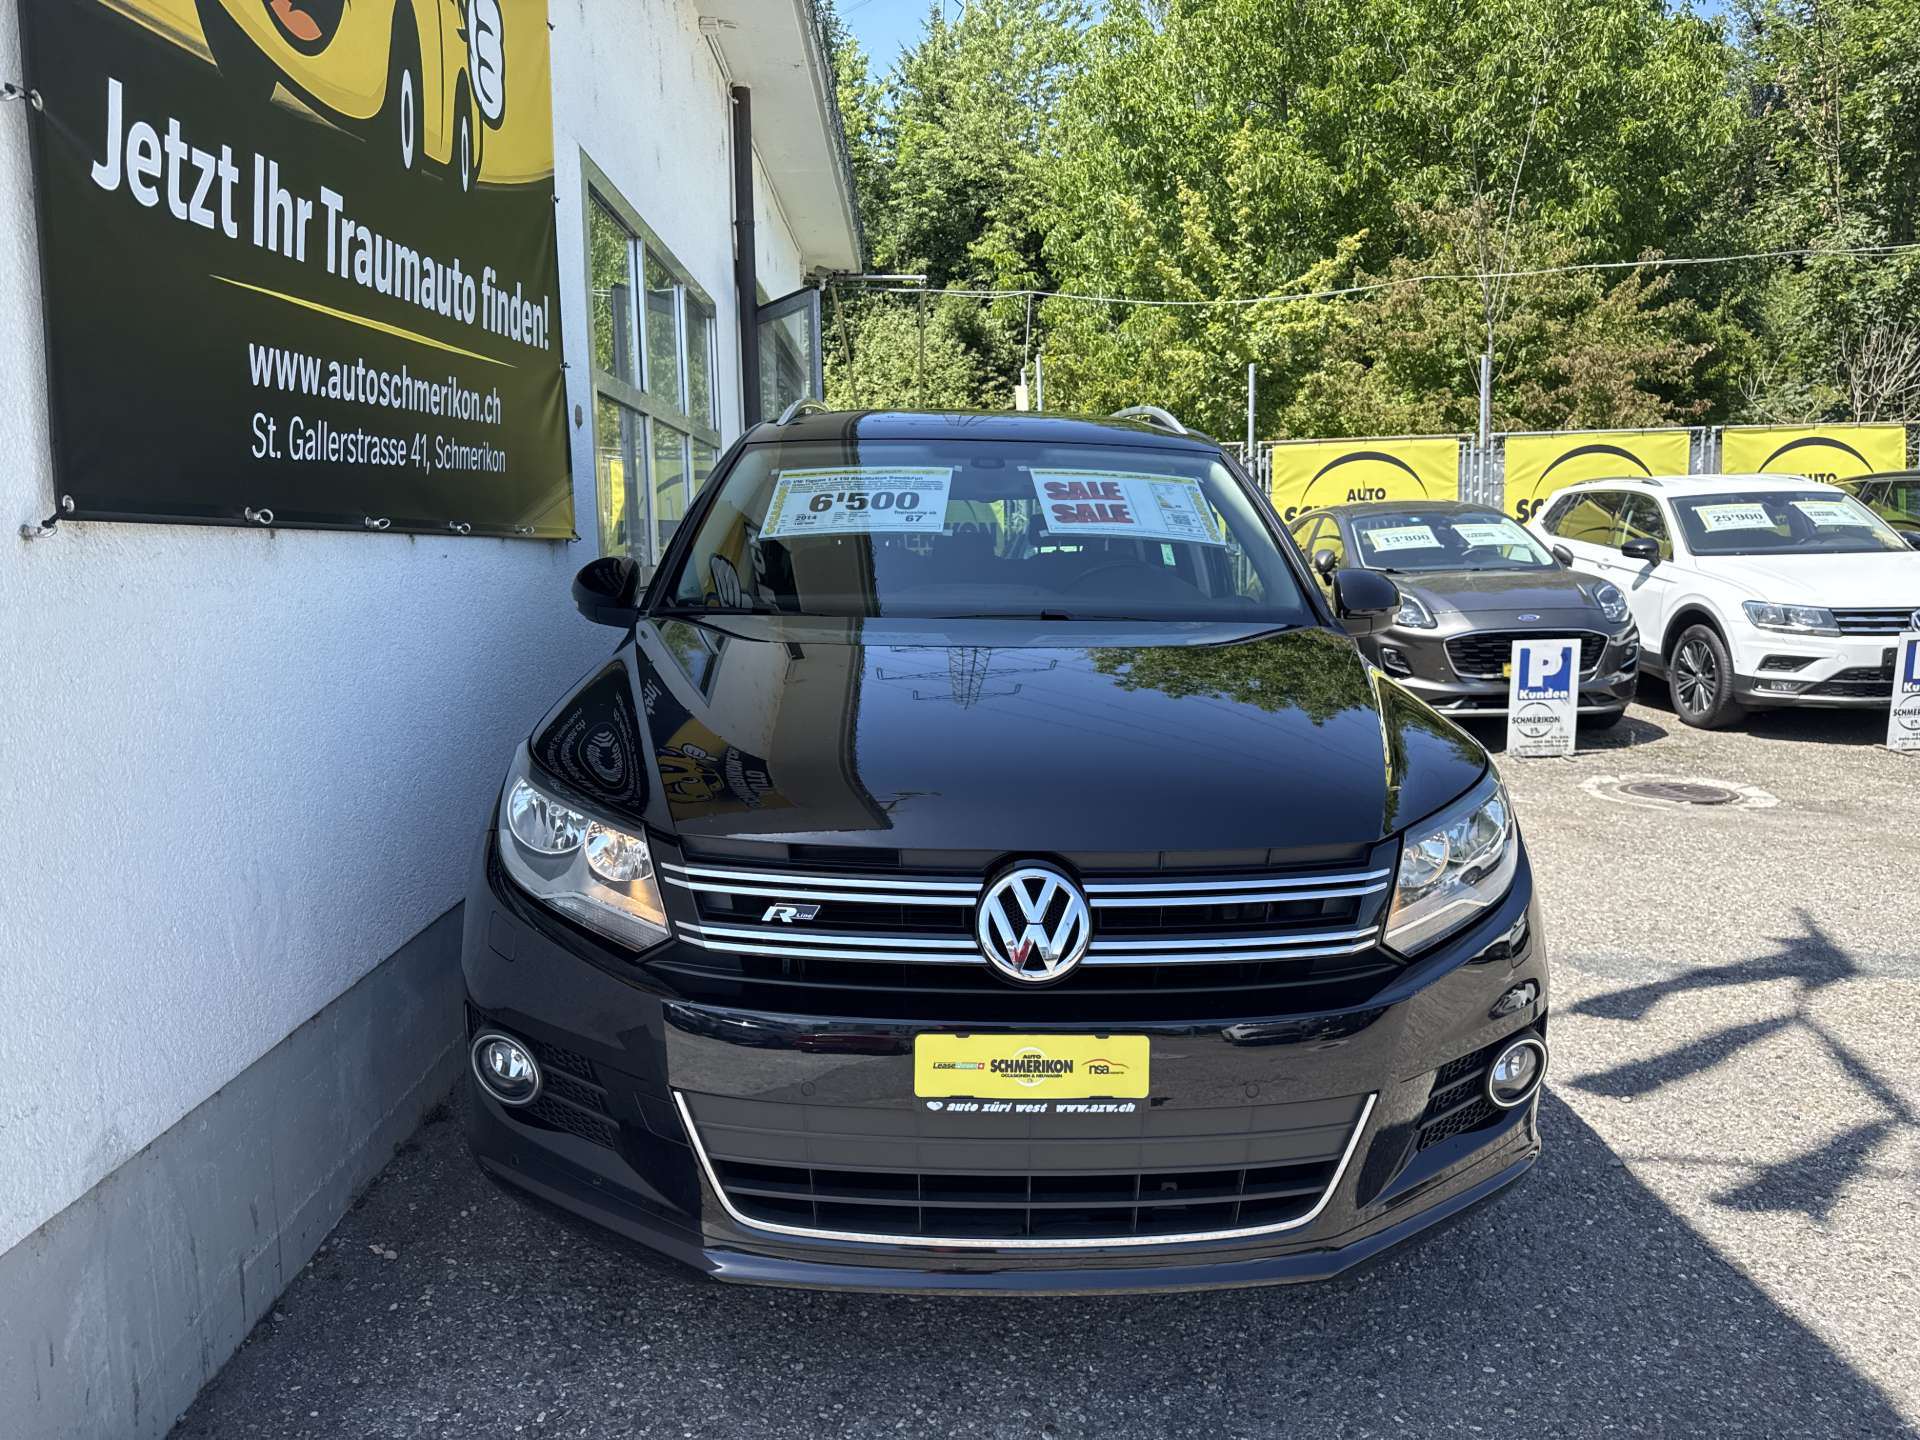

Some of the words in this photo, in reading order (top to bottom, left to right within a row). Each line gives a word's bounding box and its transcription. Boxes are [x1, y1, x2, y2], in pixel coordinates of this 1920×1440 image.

[91, 77, 239, 239] Jetzt
[253, 152, 312, 263] Ihr
[320, 186, 477, 326] Traumauto
[481, 264, 550, 351] finden!
[248, 342, 502, 426] www.autoschmerikon.ch
[251, 413, 282, 460] St.
[288, 418, 407, 468] Gallerstrasse
[410, 434, 431, 475] 41,
[435, 439, 506, 473] Schmerikon
[1044, 481, 1125, 501] SALE
[1346, 488, 1387, 502] AUTO
[809, 491, 920, 513] 6'500
[795, 513, 817, 521] 2014
[905, 514, 923, 522] 67
[1051, 503, 1135, 524] SALE
[1713, 513, 1764, 523] 25'900
[1384, 534, 1431, 544] 13'800
[1519, 688, 1569, 700] Kunden
[1511, 716, 1560, 725] SCHMERIKON
[990, 1058, 1074, 1074] SCHMERIKON
[1088, 1064, 1110, 1075] nsa
[946, 1102, 979, 1113] auto
[1015, 1102, 1048, 1113] west
[1055, 1101, 1136, 1114] www.azw.ch
